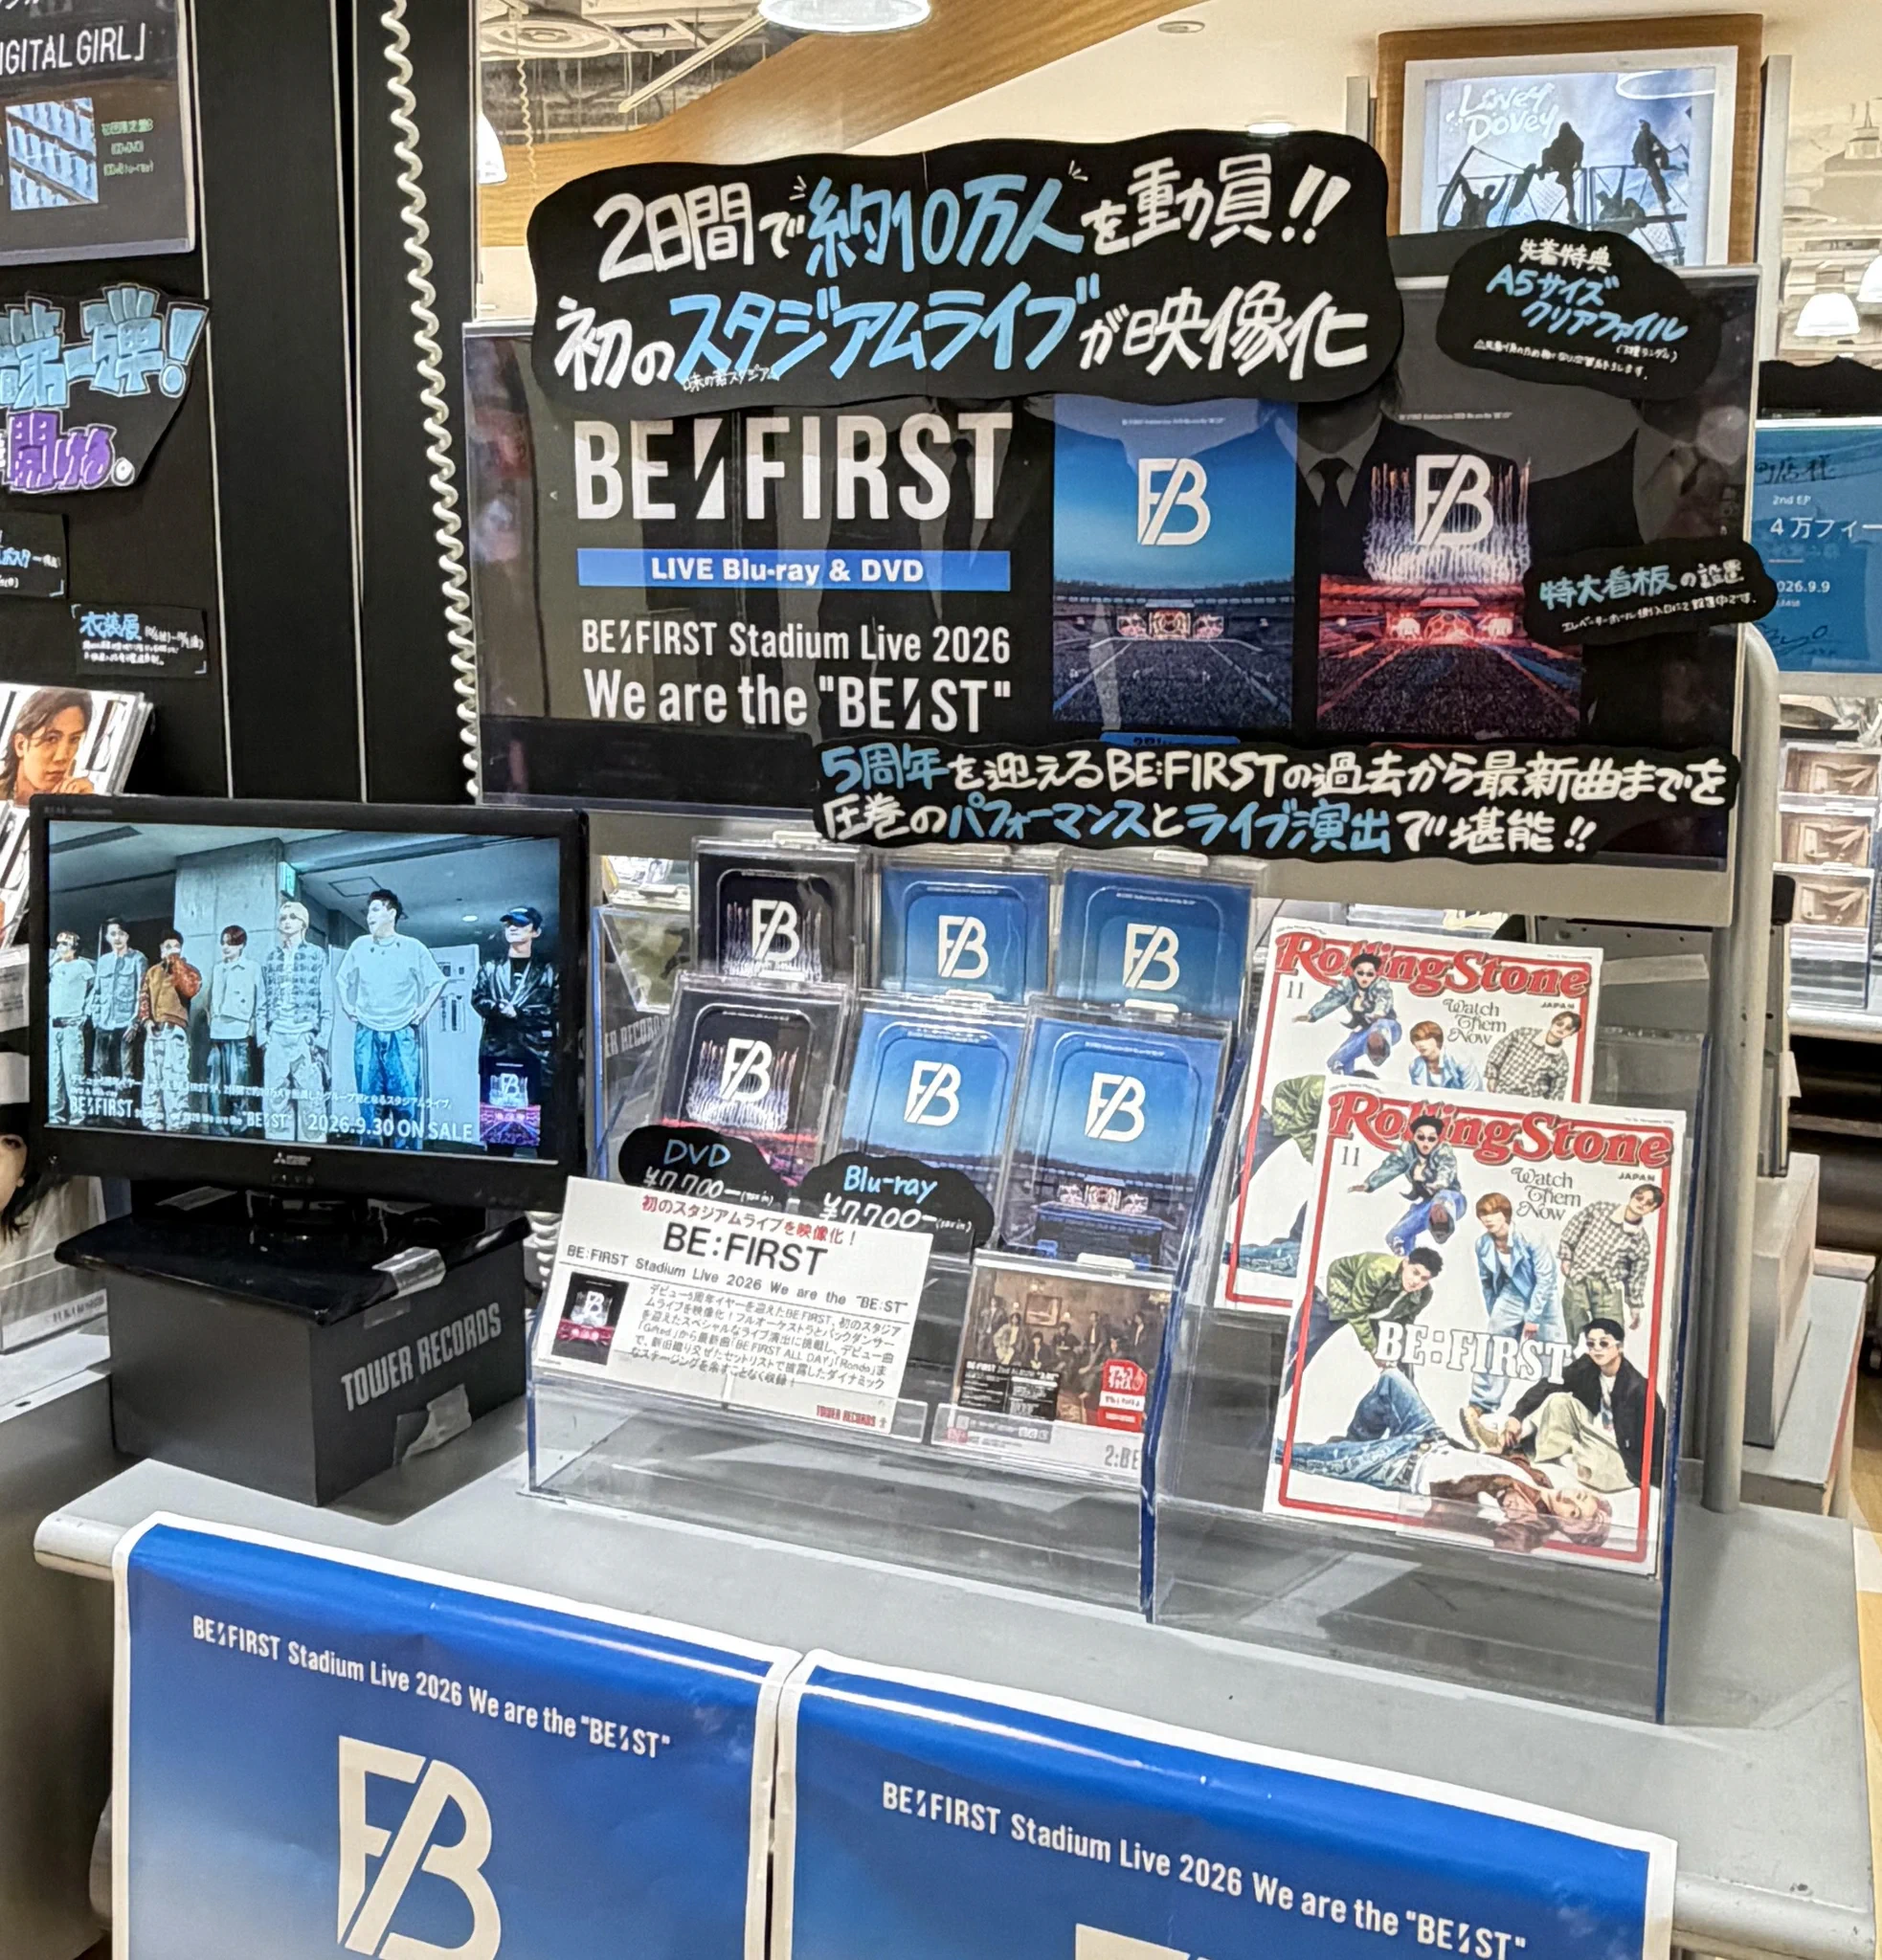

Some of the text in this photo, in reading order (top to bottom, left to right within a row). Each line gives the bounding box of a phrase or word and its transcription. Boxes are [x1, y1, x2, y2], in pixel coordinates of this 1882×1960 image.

[1466, 105, 1558, 144] Dovey
[1486, 264, 1620, 306] A5サイズ
[554, 274, 1368, 390] 初のスタジアムライブが映像化
[1521, 301, 1689, 343] クリアファイル
[651, 557, 925, 587] LIVE Blu-ray & DVD
[1777, 580, 1830, 593] 026.9.9
[582, 619, 1011, 664] BE:FIRST Stadium Live 2026
[584, 668, 646, 720] We
[659, 679, 728, 724] are
[739, 675, 808, 725] the
[1443, 998, 1499, 1017] Watch
[1454, 1014, 1507, 1034] Them
[307, 1113, 473, 1144] 2026.9.30 ON SALE
[663, 1139, 731, 1169] DVD
[843, 1165, 938, 1204] Blu-ray
[1512, 1167, 1574, 1190] Watch
[1618, 1172, 1655, 1182] JAPAN
[1516, 1203, 1566, 1222] Now
[1527, 1186, 1581, 1208] Them
[664, 1223, 828, 1276] BE:FIRST
[567, 1244, 628, 1267] BE:FIRST
[636, 1258, 685, 1279] Stadium
[692, 1268, 719, 1284] Live
[726, 1274, 763, 1291] 2026
[770, 1281, 791, 1297] We
[796, 1288, 818, 1301] are
[825, 1289, 846, 1305] the
[341, 1303, 503, 1412] TOWER RECORDS
[1376, 1321, 1573, 1385] BE:FIRST
[192, 1615, 280, 1660] BE:FIRST
[288, 1642, 365, 1682] Stadium
[370, 1661, 410, 1692] Live
[415, 1671, 462, 1706] 2026
[469, 1686, 500, 1717] We
[504, 1702, 538, 1728] are
[543, 1707, 576, 1738] the
[883, 1781, 1000, 1835] BE:FIRST
[1011, 1814, 1111, 1864] Stadium
[1120, 1839, 1171, 1877] Live
[1178, 1855, 1243, 1897] 2026
[1252, 1871, 1293, 1911] We
[1300, 1891, 1346, 1924] are
[1353, 1899, 1399, 1936] the
